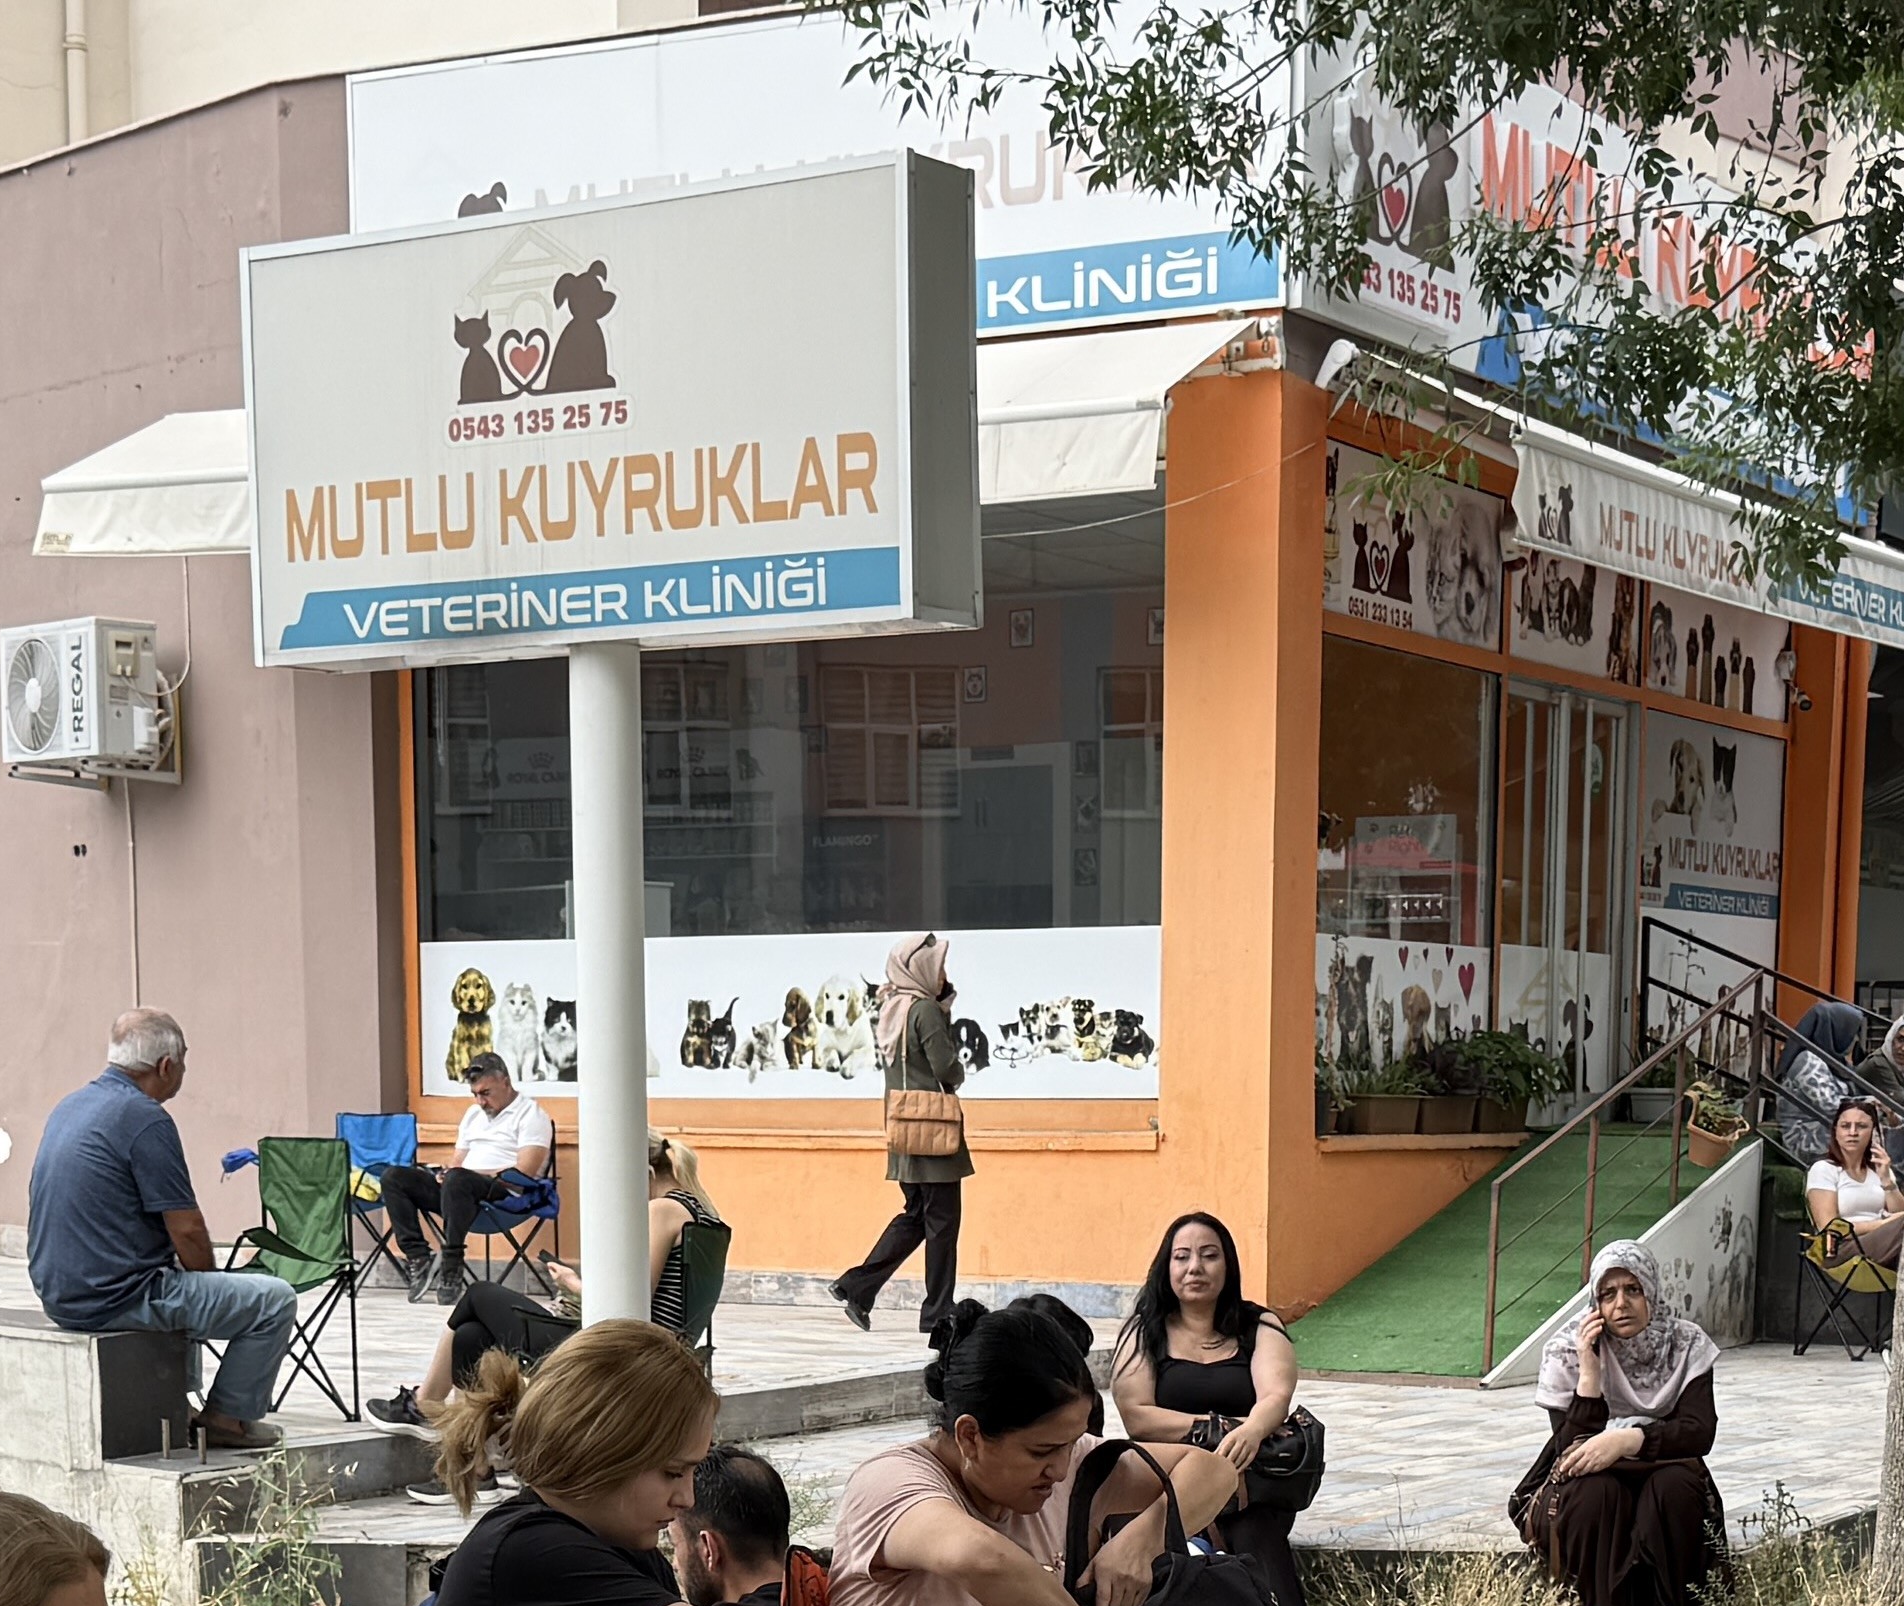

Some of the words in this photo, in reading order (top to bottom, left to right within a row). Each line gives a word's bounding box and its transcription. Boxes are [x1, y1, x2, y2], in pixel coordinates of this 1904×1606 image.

[987, 246, 1218, 318] KLİNİĞİ
[1388, 267, 1416, 308] 135
[1420, 279, 1440, 315] 25
[1444, 287, 1462, 324] 75
[448, 413, 505, 442] 0543
[513, 407, 555, 435] 135
[562, 403, 591, 431] 25
[599, 399, 628, 426] 75
[286, 472, 475, 563] MUTLU
[499, 432, 879, 546] KUYRUKLAR
[1599, 502, 1657, 560] MUTLU
[343, 582, 629, 638] VETERİNER
[643, 557, 827, 618] KLİNİĞİ
[71, 635, 84, 732] REGAL
[1669, 837, 1710, 873] MUTLU
